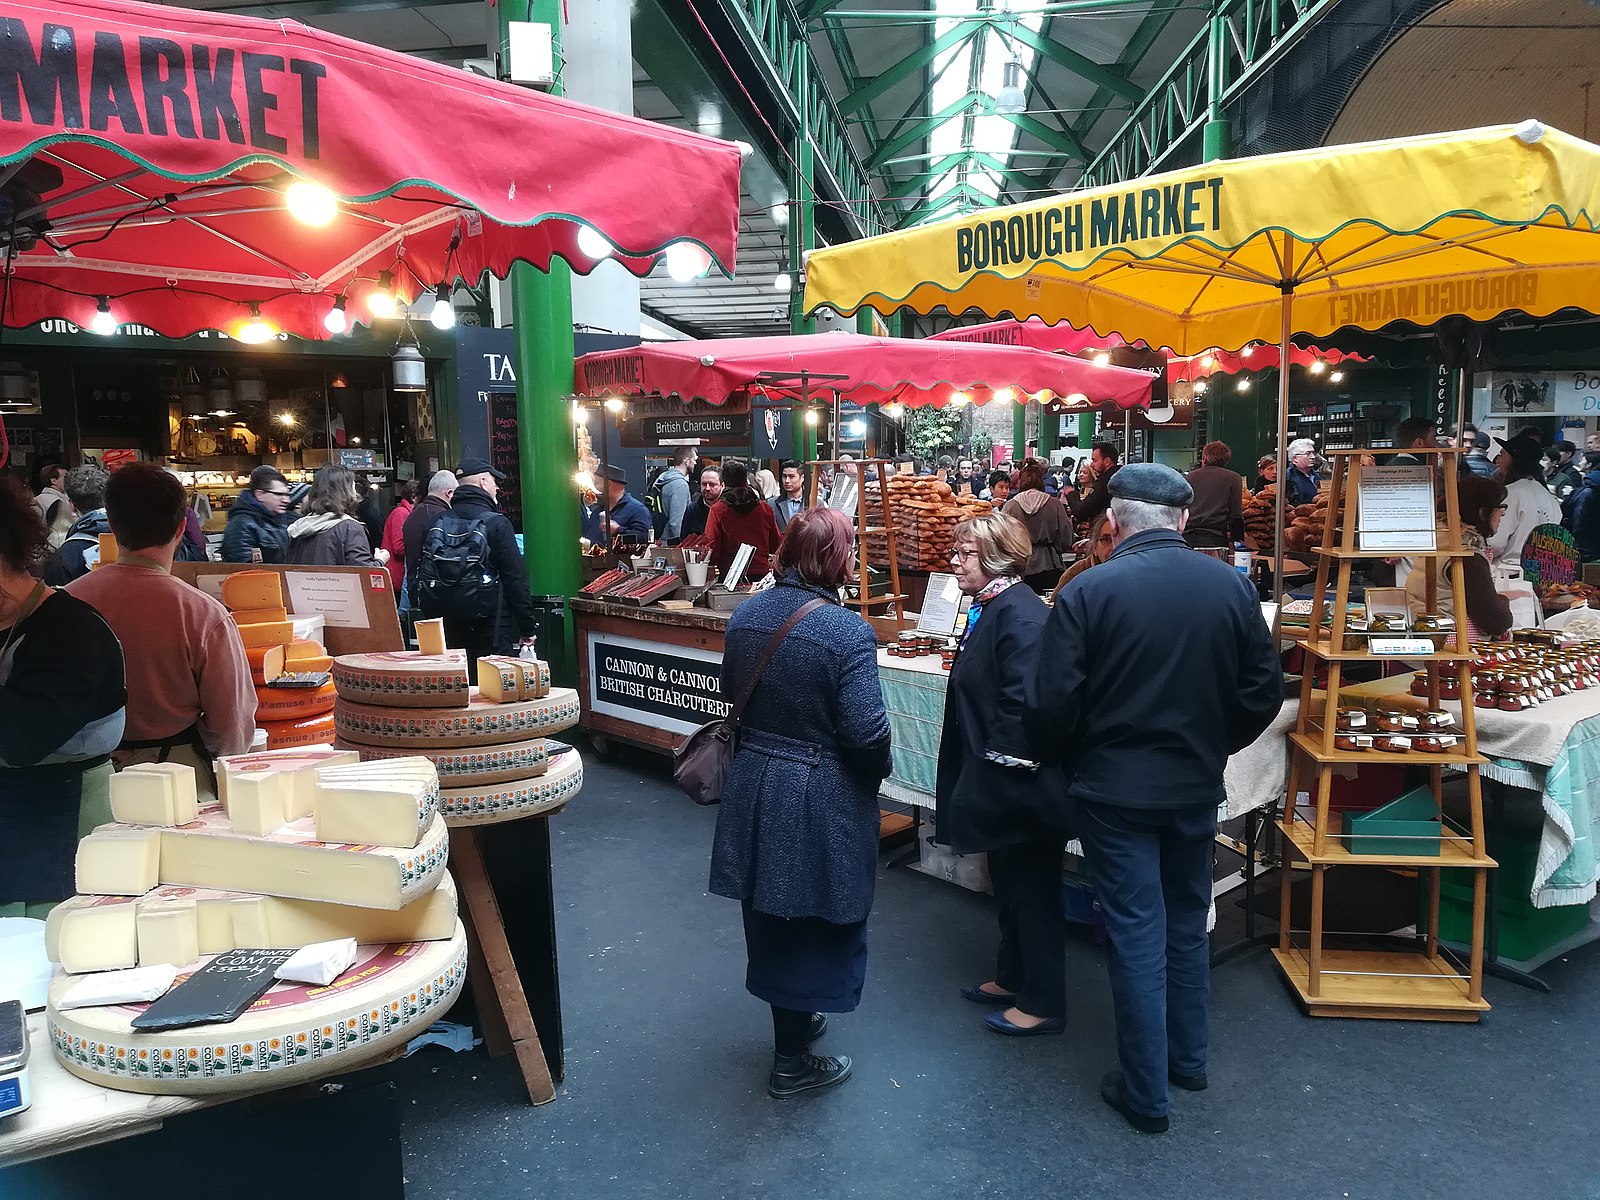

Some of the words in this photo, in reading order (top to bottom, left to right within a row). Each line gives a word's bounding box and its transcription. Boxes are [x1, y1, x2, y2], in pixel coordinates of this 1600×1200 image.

[0, 18, 327, 160] MARKET
[957, 204, 1083, 273] BOROUGH
[1090, 177, 1223, 248] MARKET
[584, 359, 613, 388] BOROUGH
[614, 356, 645, 383] MARKET
[656, 421, 681, 433] British
[683, 418, 731, 432] Charcuterie
[605, 656, 654, 680] CANNON
[658, 667, 668, 683] &
[600, 676, 645, 698] BRITISH
[647, 686, 734, 718] CHARCUTERI
